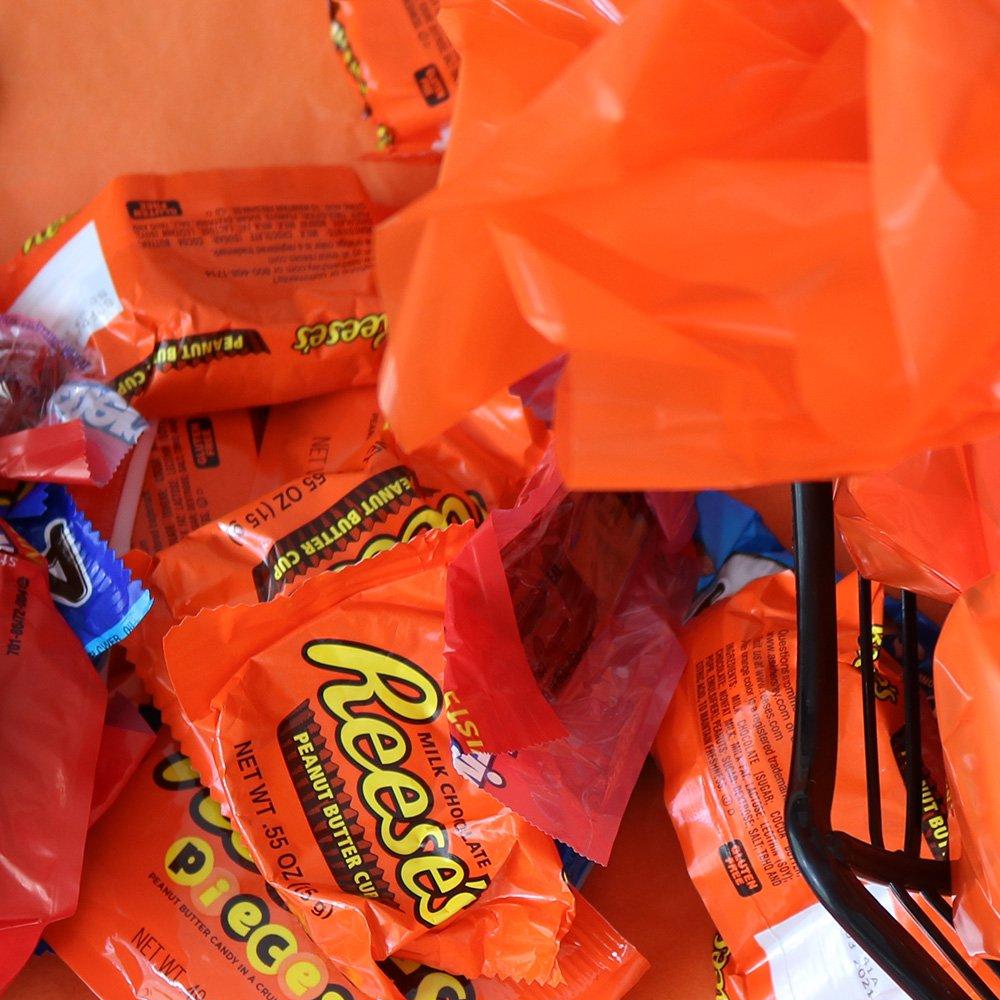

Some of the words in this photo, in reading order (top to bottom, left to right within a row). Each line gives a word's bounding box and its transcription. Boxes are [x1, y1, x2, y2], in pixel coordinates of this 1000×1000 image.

[273, 486, 302, 511] OZ
[361, 477, 410, 515] EANUT
[301, 509, 360, 555] BUTTER
[272, 550, 300, 580] CUP
[777, 628, 789, 673] Questions
[731, 694, 741, 713] MILK
[737, 719, 759, 764] CHOCOLATE
[743, 676, 754, 695] color
[753, 715, 775, 754] registered
[417, 732, 448, 778] MILK
[293, 732, 334, 800] PEANUT
[323, 803, 362, 868] BUTTER
[302, 638, 490, 928] Reese's
[233, 740, 262, 781] NET
[248, 783, 275, 816] WT
[262, 822, 289, 850] .55
[277, 852, 303, 882] OZ
[725, 857, 744, 885] FREE
[731, 846, 757, 888] GLUTEN
[748, 828, 764, 850] SALT;
[767, 871, 781, 886] AND
[130, 928, 164, 961] NET
[148, 872, 180, 905] PEANUT
[179, 904, 211, 937] BUTTER
[210, 936, 239, 964] CANDY
[237, 964, 249, 975] IN
[247, 973, 257, 983] A
